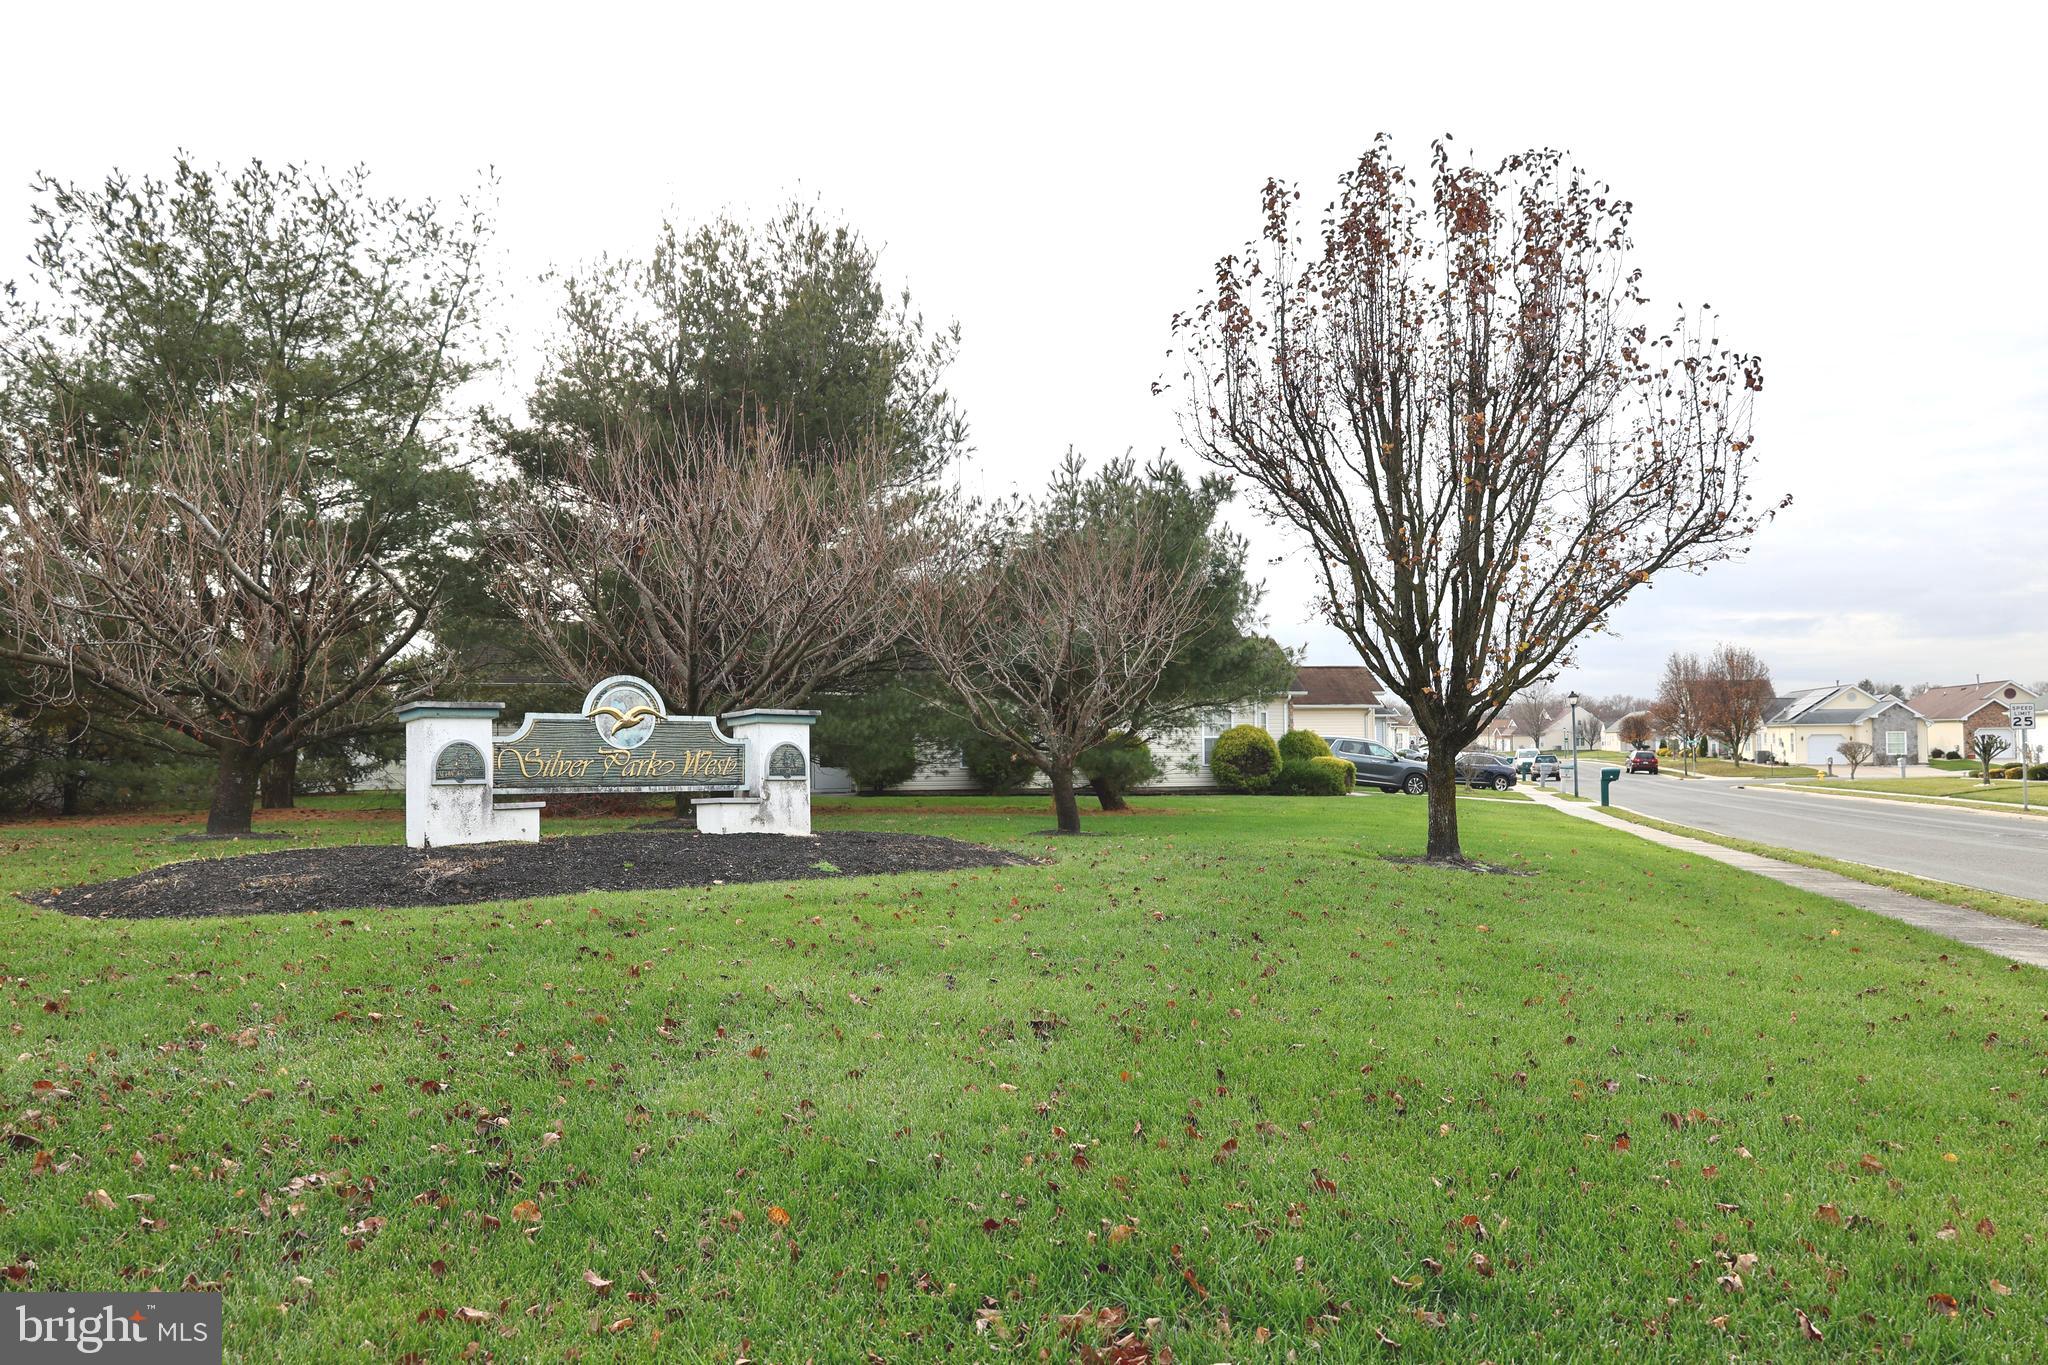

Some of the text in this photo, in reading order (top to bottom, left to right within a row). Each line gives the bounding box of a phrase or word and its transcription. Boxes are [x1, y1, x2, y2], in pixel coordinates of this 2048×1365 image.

[2013, 717, 2033, 726] 25
[497, 746, 737, 778] Silver Park West
